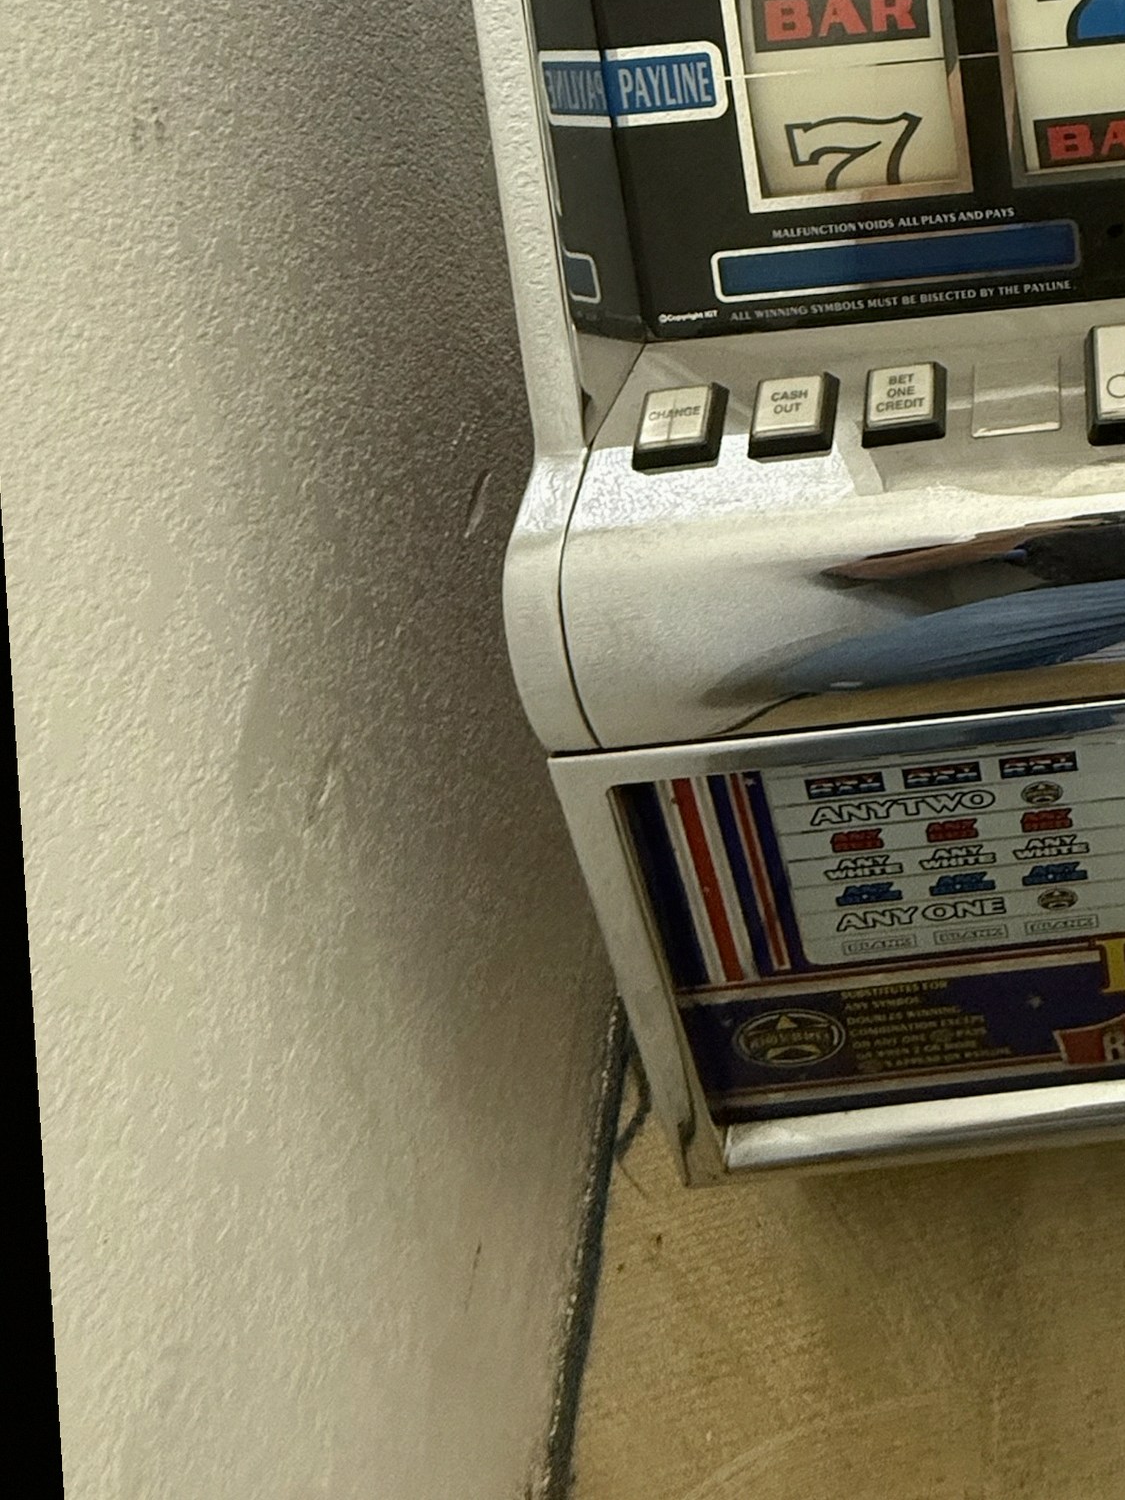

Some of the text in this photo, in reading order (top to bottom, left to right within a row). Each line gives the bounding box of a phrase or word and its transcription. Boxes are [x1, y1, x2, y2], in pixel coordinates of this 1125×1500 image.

[617, 61, 713, 110] PAYLINE
[785, 111, 922, 190] 7
[772, 207, 1015, 238] MALFUNCTION VOIDS ALL PLAYS AND PAYS
[730, 312, 751, 322] ALL
[754, 305, 808, 319] WINNING
[811, 300, 864, 314] SYMBOLS
[867, 297, 897, 309] MUST
[902, 295, 916, 305] BE
[920, 289, 976, 303] BISECTED
[980, 288, 994, 298] BY
[999, 286, 1020, 295] THE
[888, 373, 914, 386] BET
[771, 390, 809, 402] CASH
[887, 385, 915, 398] ONE
[648, 406, 702, 421] CHANGE
[774, 402, 802, 415] OUT
[876, 397, 925, 413] CREDIT
[811, 790, 995, 826] ANY TWO
[836, 906, 918, 932] ANY
[922, 897, 1007, 921] ONE
